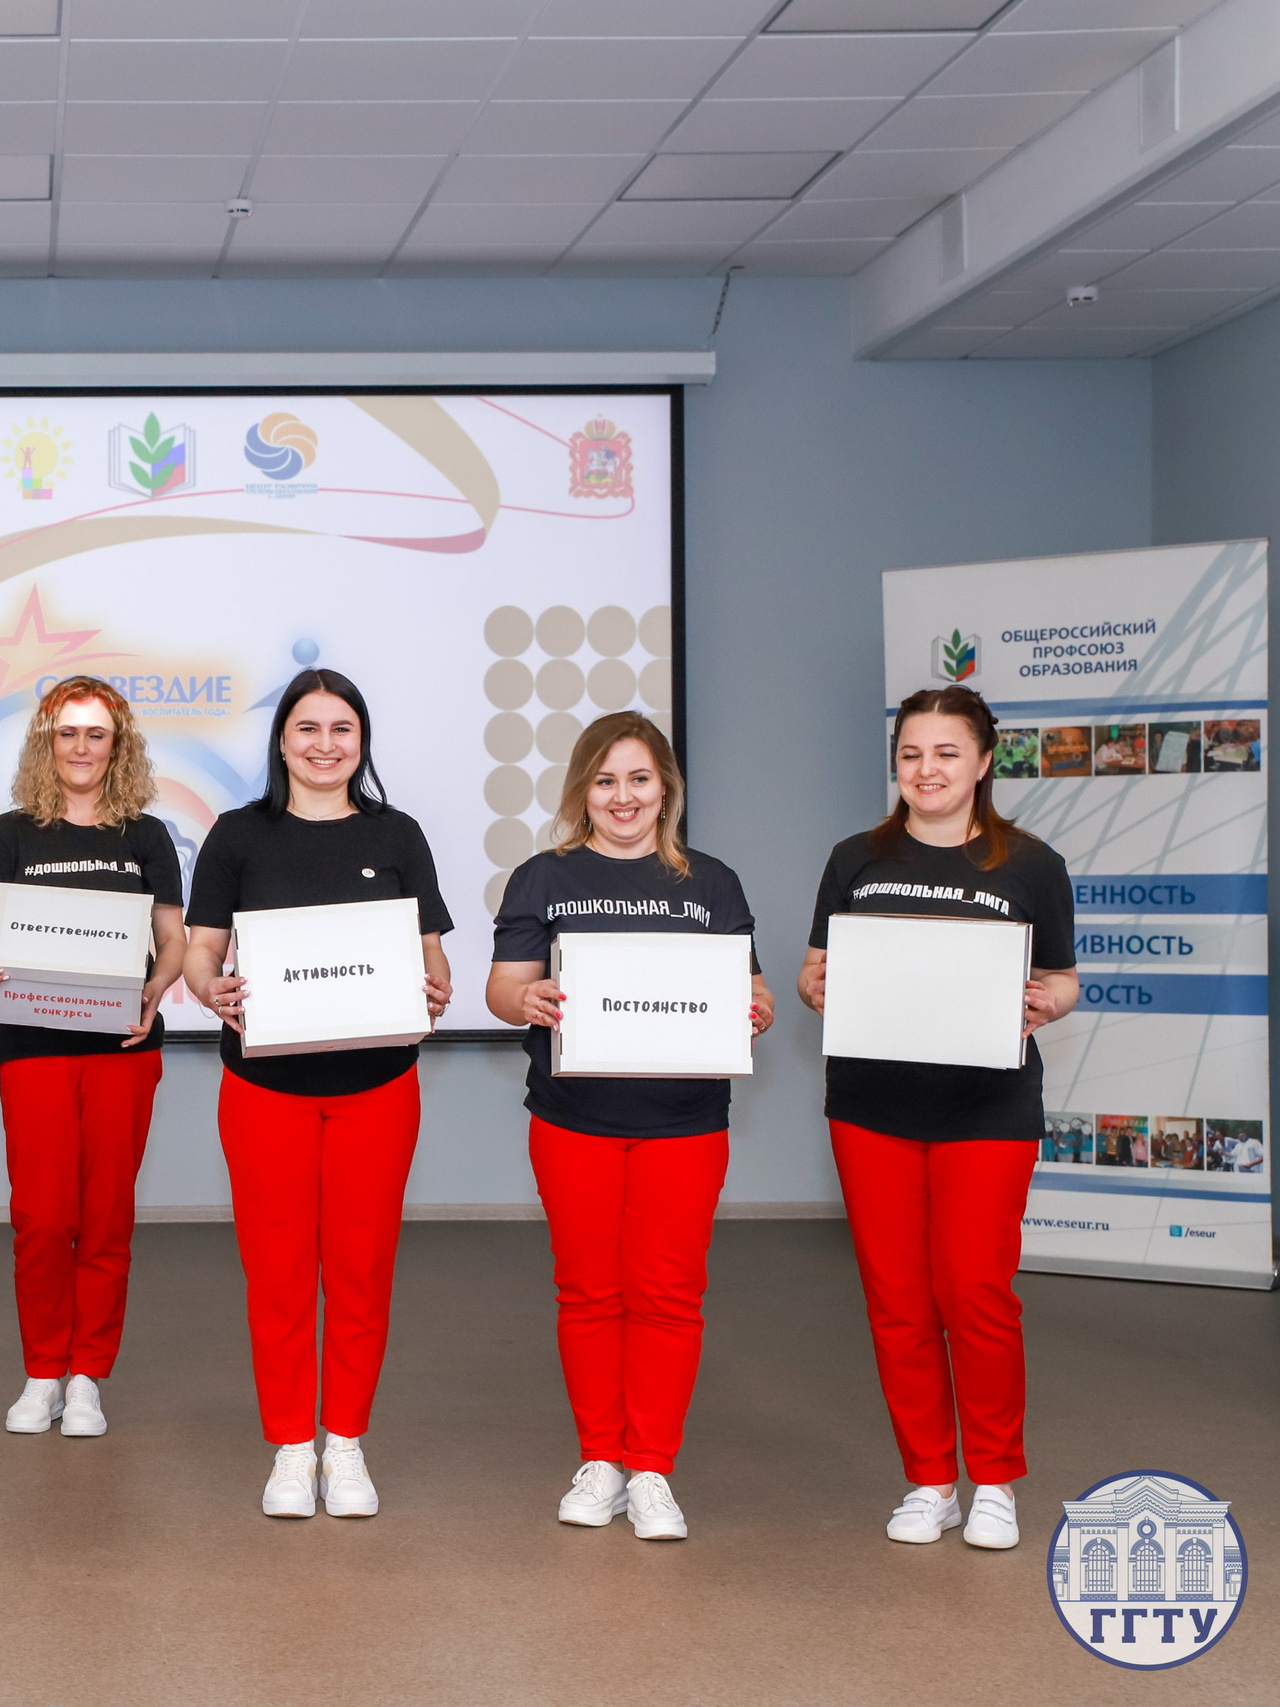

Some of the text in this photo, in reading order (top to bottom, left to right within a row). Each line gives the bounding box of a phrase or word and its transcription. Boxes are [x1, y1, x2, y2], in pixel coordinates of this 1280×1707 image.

[1001, 619, 1156, 644] ОБЩЕРОССИЙСКИЙ
[1033, 642, 1124, 658] ПРОФСОЮЗ
[1020, 659, 1138, 677] ОБРАЗОВАНИЯ
[34, 675, 231, 704] СВЕЗДИЕ
[852, 882, 1010, 915] #ДОШКОЛЬНАЯ_ЛИГА
[1076, 884, 1196, 905] ЕННОСТЬ
[10, 921, 129, 940] Ответственность
[284, 964, 374, 983] Активность
[4, 990, 122, 1008] Профессиональные
[602, 998, 708, 1014] Постоянство
[34, 1007, 92, 1018] конкурсы
[1021, 1218, 1109, 1232] www.eseur.ru
[1185, 1227, 1216, 1239] /eseur
